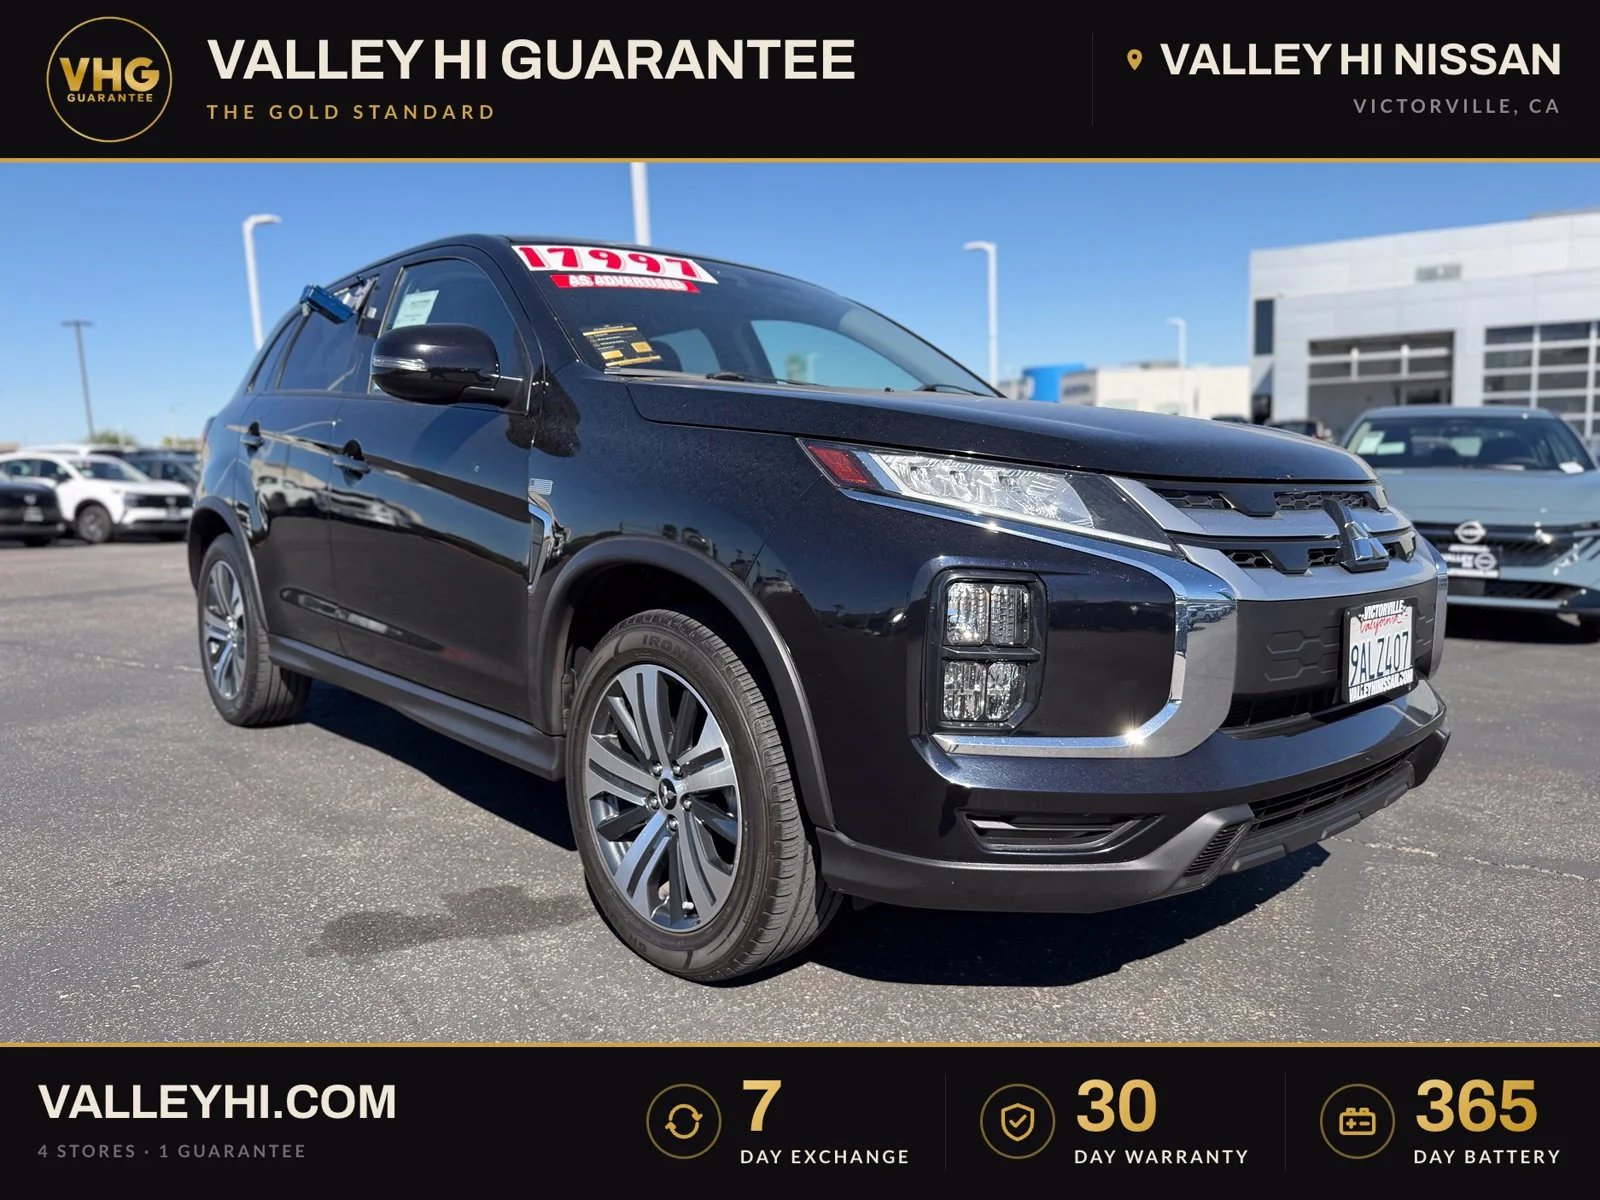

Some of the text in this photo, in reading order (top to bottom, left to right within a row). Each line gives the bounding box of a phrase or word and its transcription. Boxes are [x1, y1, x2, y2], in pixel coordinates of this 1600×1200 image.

[519, 247, 699, 278] 17997
[568, 275, 688, 291] AS ADVERTISED
[1364, 600, 1405, 620] VICTORVILLE
[1350, 631, 1409, 687] 9ALZ407
